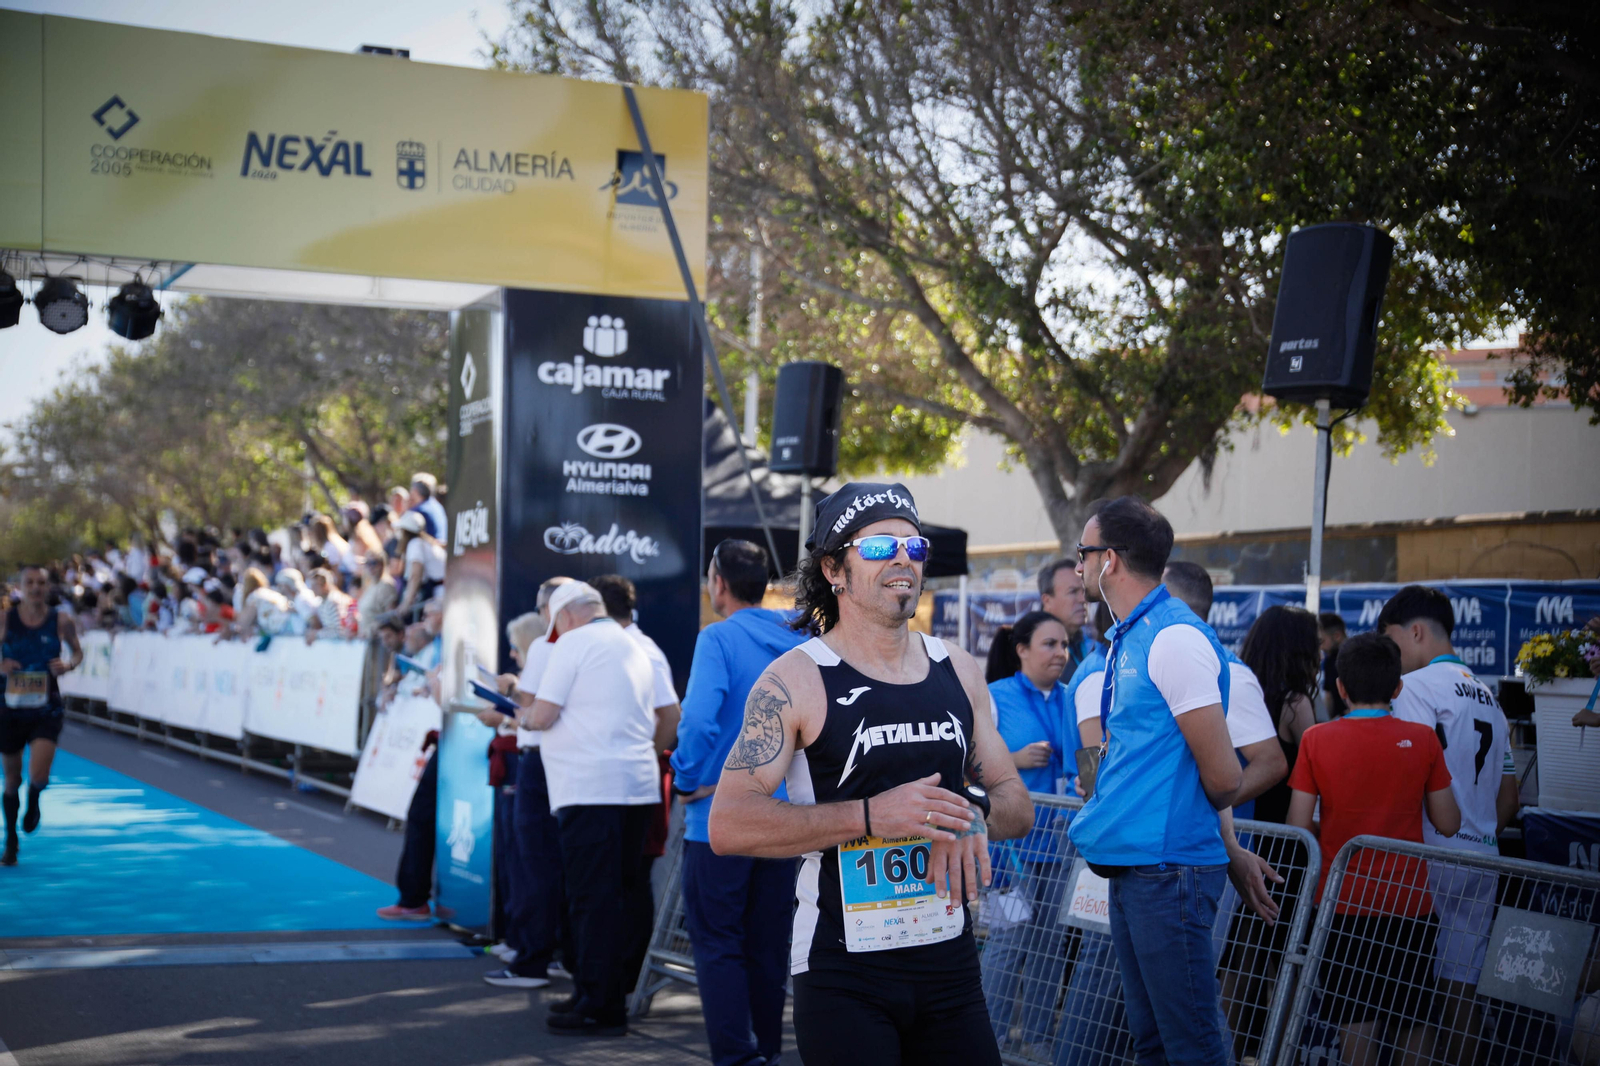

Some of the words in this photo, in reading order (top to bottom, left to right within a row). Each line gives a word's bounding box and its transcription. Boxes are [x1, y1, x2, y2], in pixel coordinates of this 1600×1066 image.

[90, 143, 212, 170] COOPERACIÓN
[240, 130, 372, 178] NEXAL
[453, 148, 576, 181] ALMERÍA
[90, 158, 132, 178] 2005
[452, 174, 516, 194] CIUDAD
[537, 354, 671, 394] cajamar
[601, 388, 629, 399] CAJA
[630, 390, 666, 402] RURAL
[562, 460, 652, 480] HYUNDAI
[565, 478, 649, 496] Almerialva
[1455, 640, 1496, 667] ería
[837, 710, 967, 788] METALLICA
[1473, 717, 1494, 786] 7
[856, 844, 930, 886] 160
[894, 882, 923, 894] MARA
